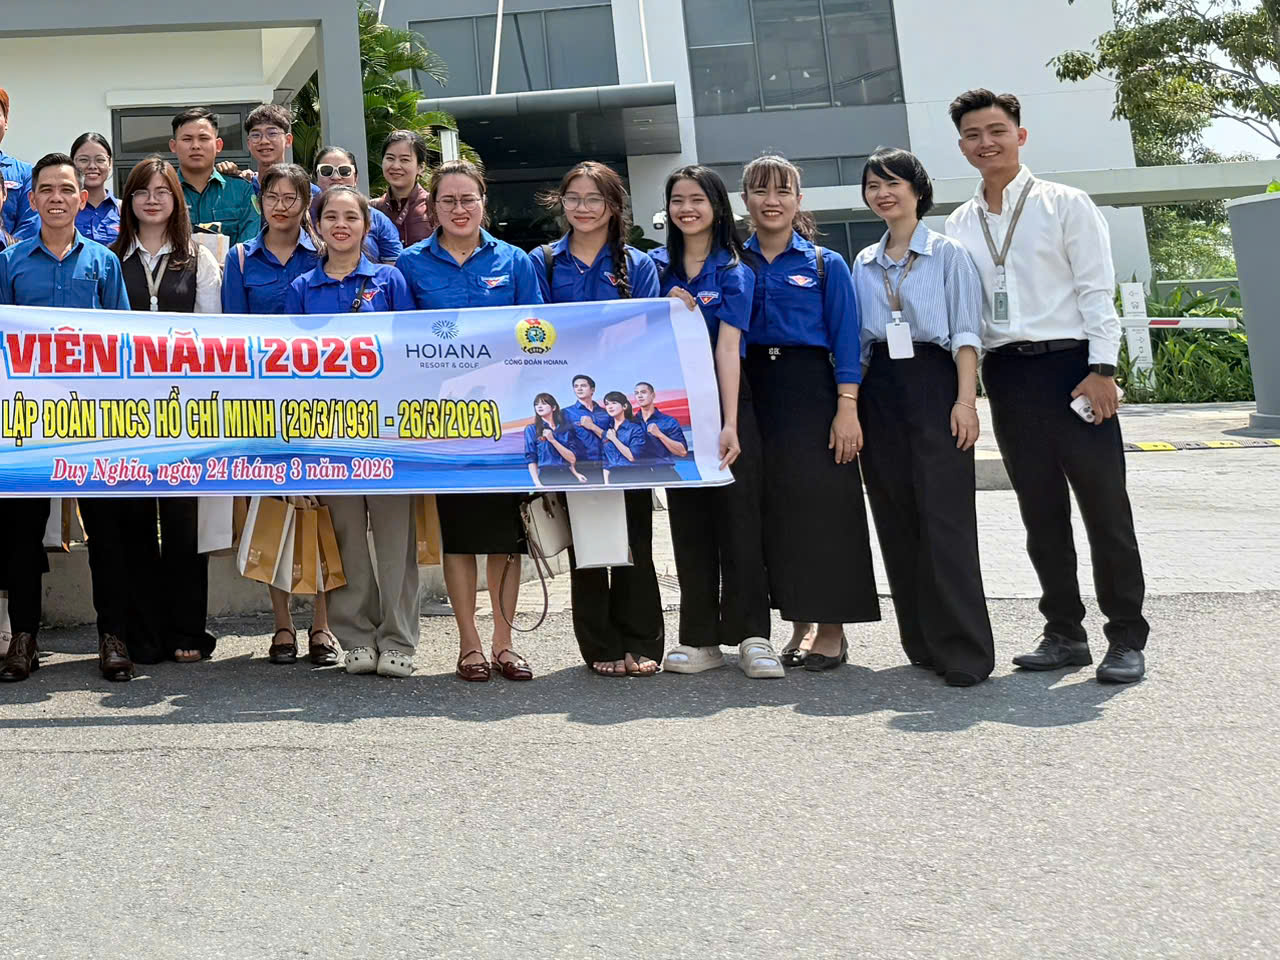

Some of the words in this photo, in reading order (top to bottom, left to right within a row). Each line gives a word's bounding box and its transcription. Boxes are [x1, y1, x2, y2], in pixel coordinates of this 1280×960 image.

[6, 325, 120, 376] VIÊN
[131, 329, 249, 376] NĂM
[261, 334, 381, 377] 2026
[405, 343, 492, 359] HOIANA
[504, 358, 523, 366] CÔNG
[524, 358, 542, 366] ĐOÀN
[452, 361, 457, 369] &
[459, 361, 479, 369] GOLF
[2, 391, 39, 447] LẬP
[42, 391, 96, 439] ĐOÀN
[99, 399, 151, 438] TNCS
[154, 386, 182, 438] HỒ
[186, 391, 220, 438] CHÍ
[222, 399, 277, 438] MINH
[280, 399, 379, 442] (26/3/1931
[384, 416, 395, 427] -
[397, 399, 502, 442] 26/3/2026)
[51, 457, 88, 485] Duy
[91, 457, 153, 485] Nghĩa,
[157, 457, 202, 485] ngày
[206, 457, 228, 480] 24
[232, 456, 286, 484] tháng
[290, 457, 302, 480] 3
[306, 457, 348, 480] năm
[352, 457, 393, 480] 2026
